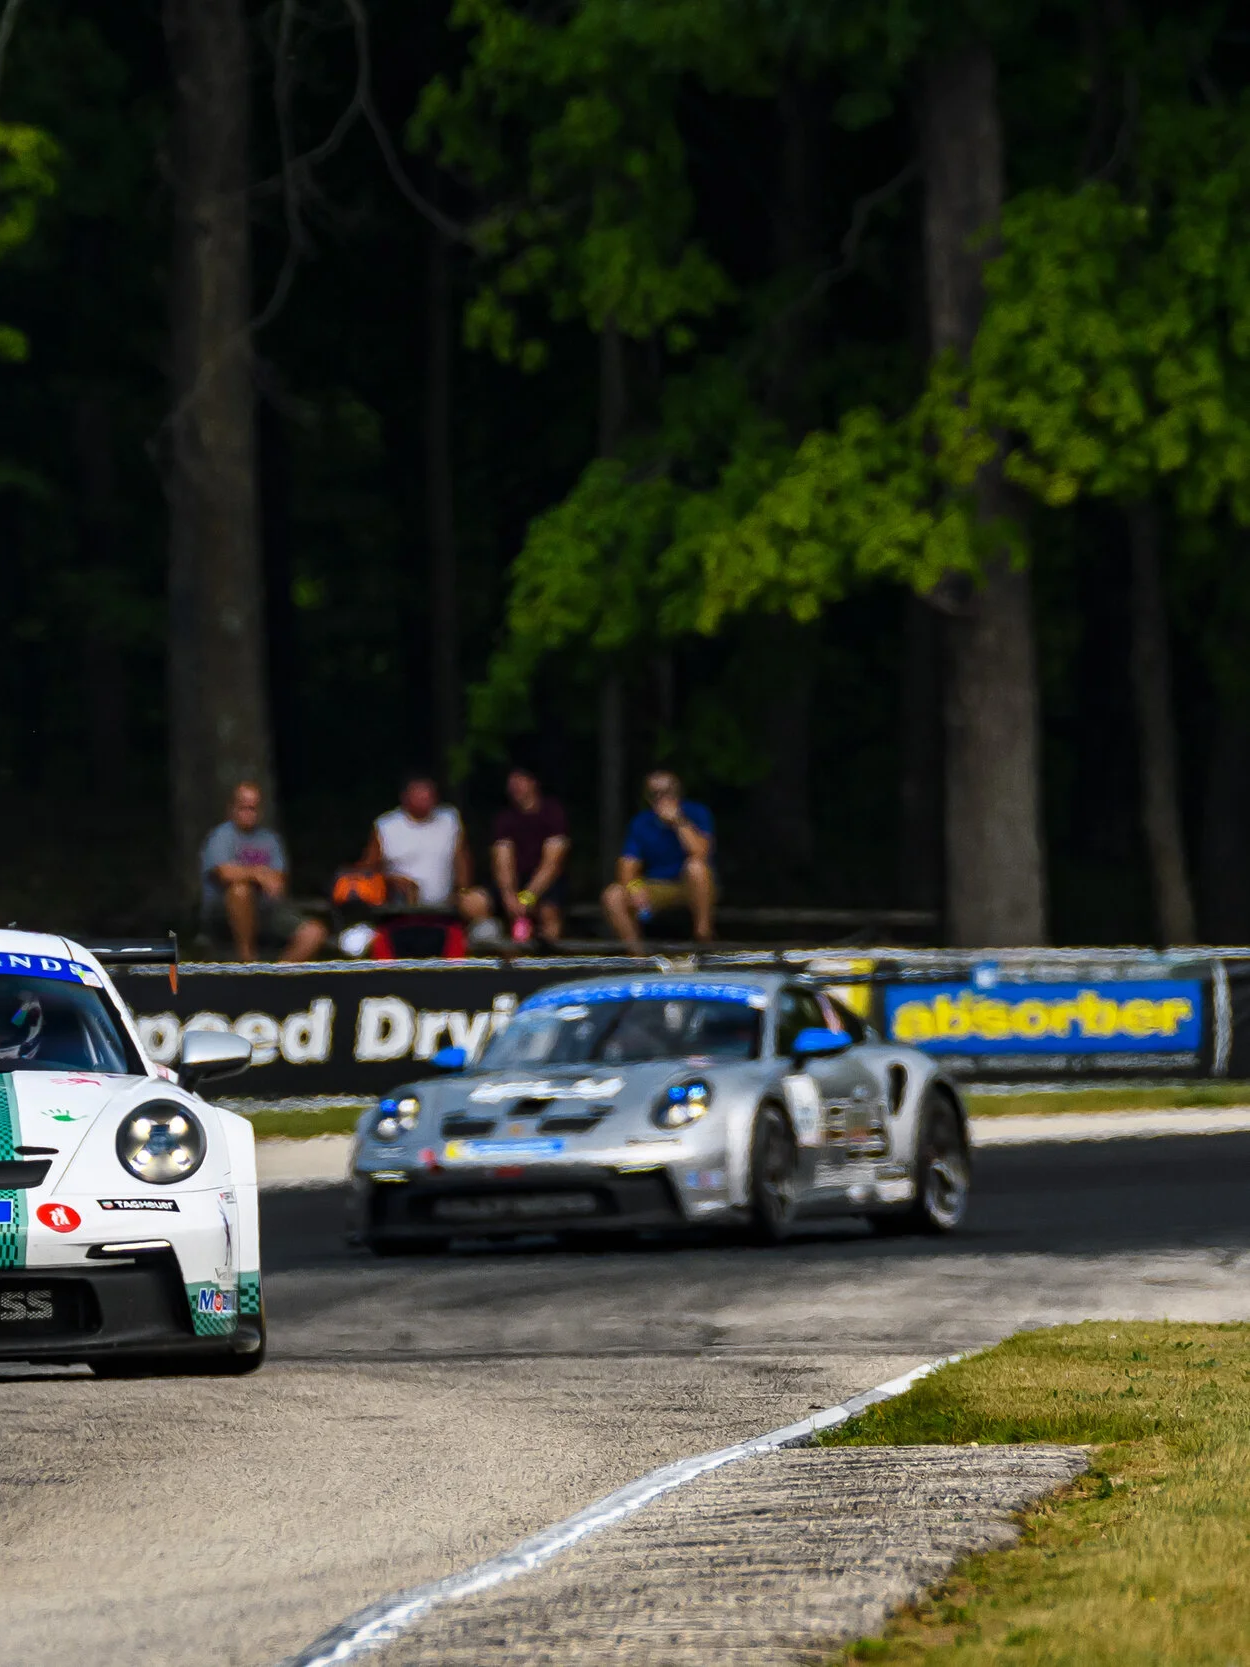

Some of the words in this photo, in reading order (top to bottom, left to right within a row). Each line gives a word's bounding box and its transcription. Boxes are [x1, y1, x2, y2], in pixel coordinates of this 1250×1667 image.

[134, 994, 336, 1067] ped
[354, 992, 518, 1069] Dryi
[893, 990, 1192, 1042] absorber
